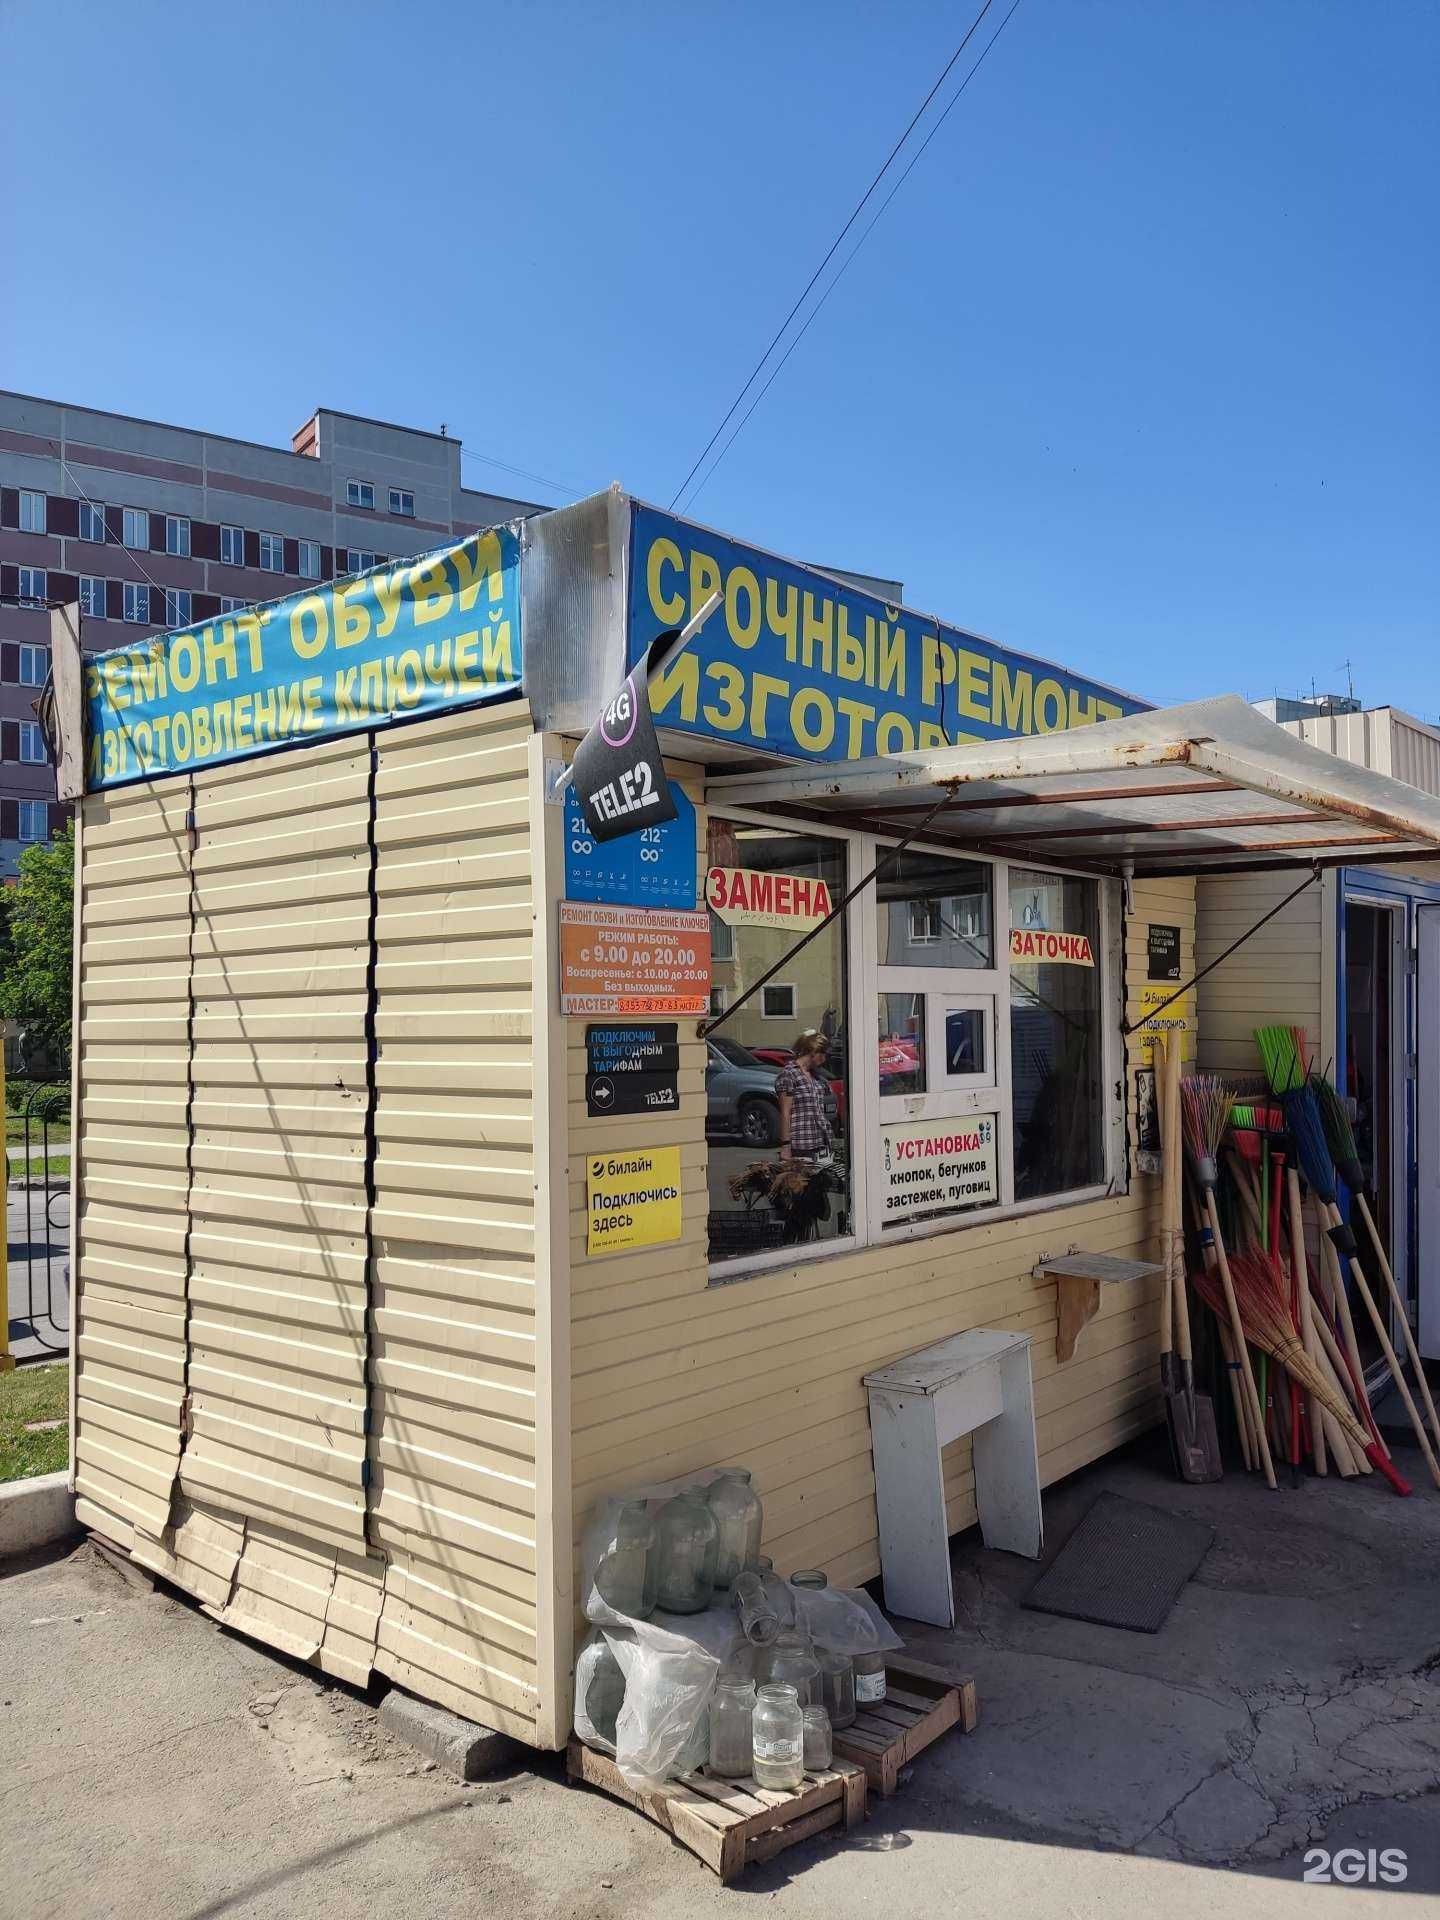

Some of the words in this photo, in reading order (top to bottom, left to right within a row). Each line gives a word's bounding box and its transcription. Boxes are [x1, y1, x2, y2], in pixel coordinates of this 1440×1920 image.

[289, 528, 505, 659] ОБУВИ
[646, 537, 906, 697] СРОЧНЫЙ
[334, 607, 515, 723] КЛЮЧЕЙ
[605, 692, 631, 725] 4G
[589, 761, 660, 822] TELE2
[709, 868, 830, 918] ЗАМЕНА
[561, 908, 593, 922] РЕМОНТ
[594, 913, 617, 924] ОБУВИ
[626, 914, 679, 928] ИЗГОТОВЛЕНИЕ
[680, 915, 708, 930] КЛЮЧЕЙ
[598, 931, 635, 944] РЕЖИМ
[637, 933, 679, 946] РАБОТЫ:
[1012, 930, 1091, 961] ЗАТОЧКА
[593, 946, 628, 963] 9.00
[631, 952, 650, 967] до
[653, 948, 696, 966] 20.00
[566, 966, 634, 980] Воскресенье:
[671, 971, 683, 981] до
[684, 970, 708, 981] 20.00
[604, 981, 622, 993] Без
[624, 983, 676, 994] выходных.
[591, 1030, 655, 1044] ПОДКЛЮЧИМ
[593, 1046, 599, 1057] К
[603, 1043, 663, 1058] ВЫГОДНЫМ
[593, 1059, 642, 1073] ТАРИФАМ
[645, 1088, 675, 1105] TELE2
[896, 1133, 981, 1160] УСТАНОВКА
[607, 1158, 652, 1176] билайн
[890, 1168, 935, 1185] кнопок,
[938, 1160, 987, 1178] бегунков
[593, 1185, 677, 1211] Подключись
[886, 1188, 946, 1208] застежек,
[948, 1180, 991, 1199] пуговиц
[593, 1214, 633, 1234] здесь
